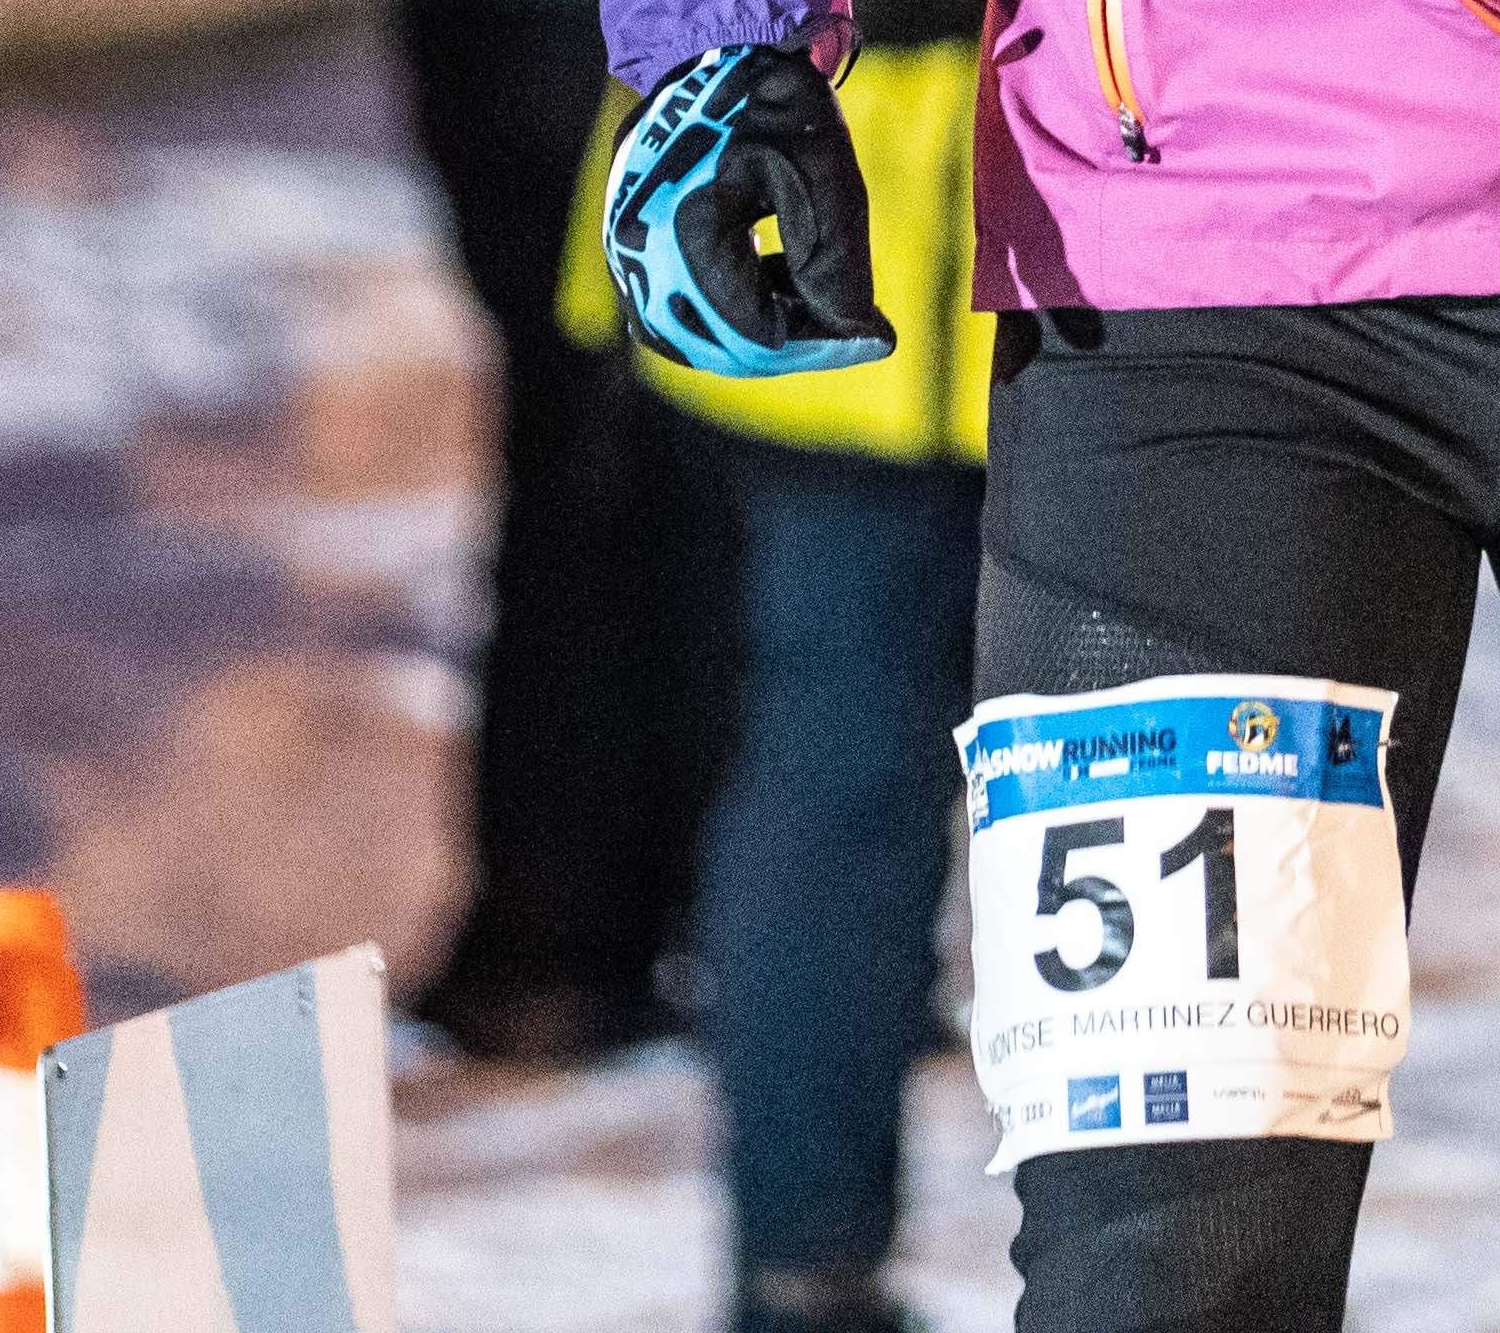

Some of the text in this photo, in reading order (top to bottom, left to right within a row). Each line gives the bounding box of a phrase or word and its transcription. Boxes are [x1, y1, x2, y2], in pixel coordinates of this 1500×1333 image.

[1206, 750, 1298, 776] FEDME
[1033, 807, 1240, 992] 51
[1072, 1001, 1236, 1037] MARTINEZ
[1246, 1000, 1399, 1041] GUERRERO
